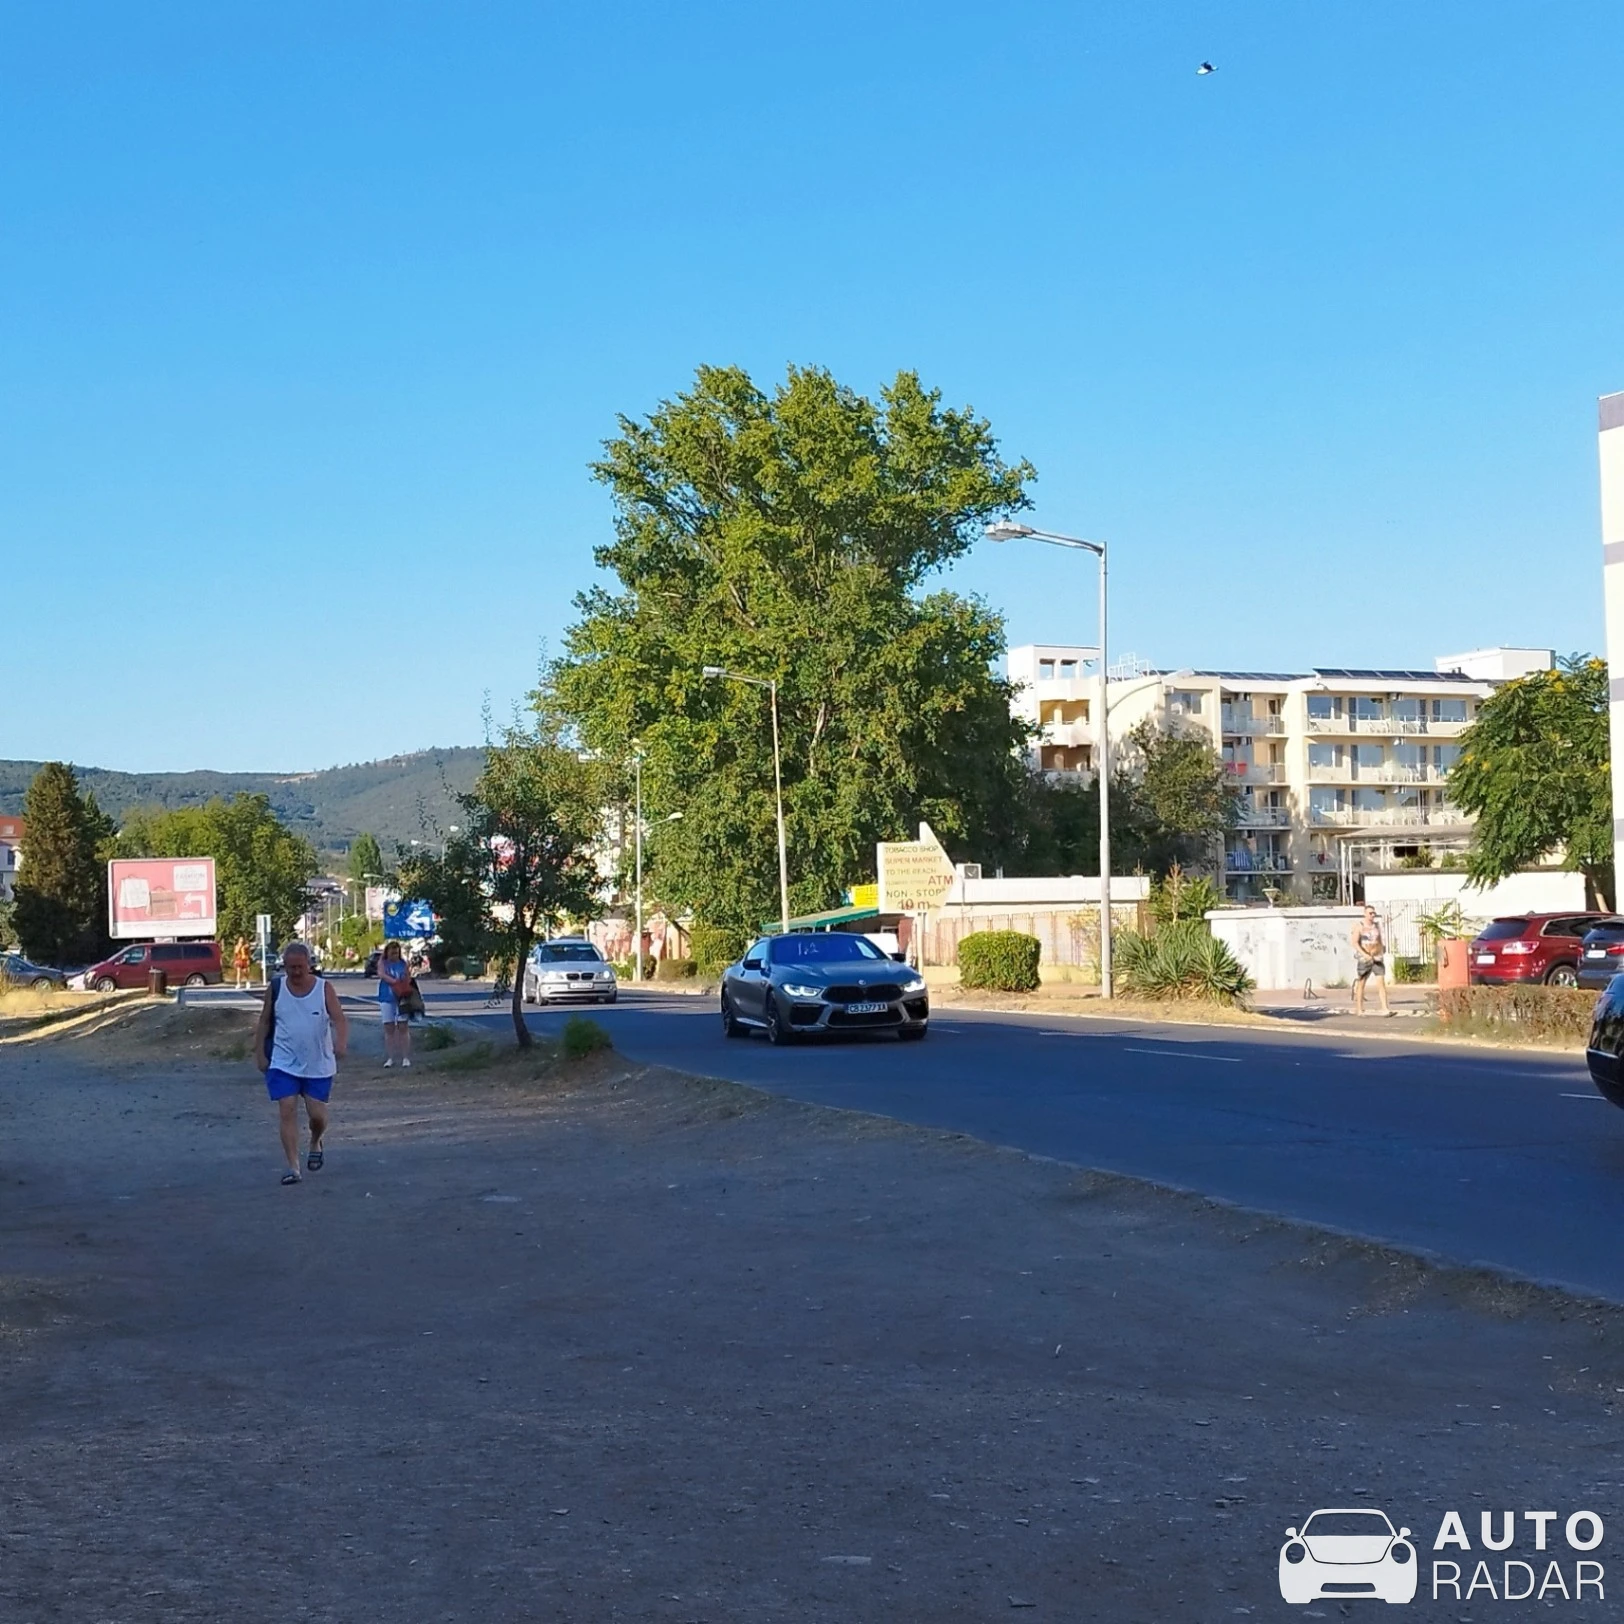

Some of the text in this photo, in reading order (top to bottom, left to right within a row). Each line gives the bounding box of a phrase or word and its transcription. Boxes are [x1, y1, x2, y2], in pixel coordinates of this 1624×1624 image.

[885, 857, 911, 865] SUPER
[928, 875, 953, 886] ATM
[886, 890, 908, 898] NON
[916, 889, 942, 897] STOP
